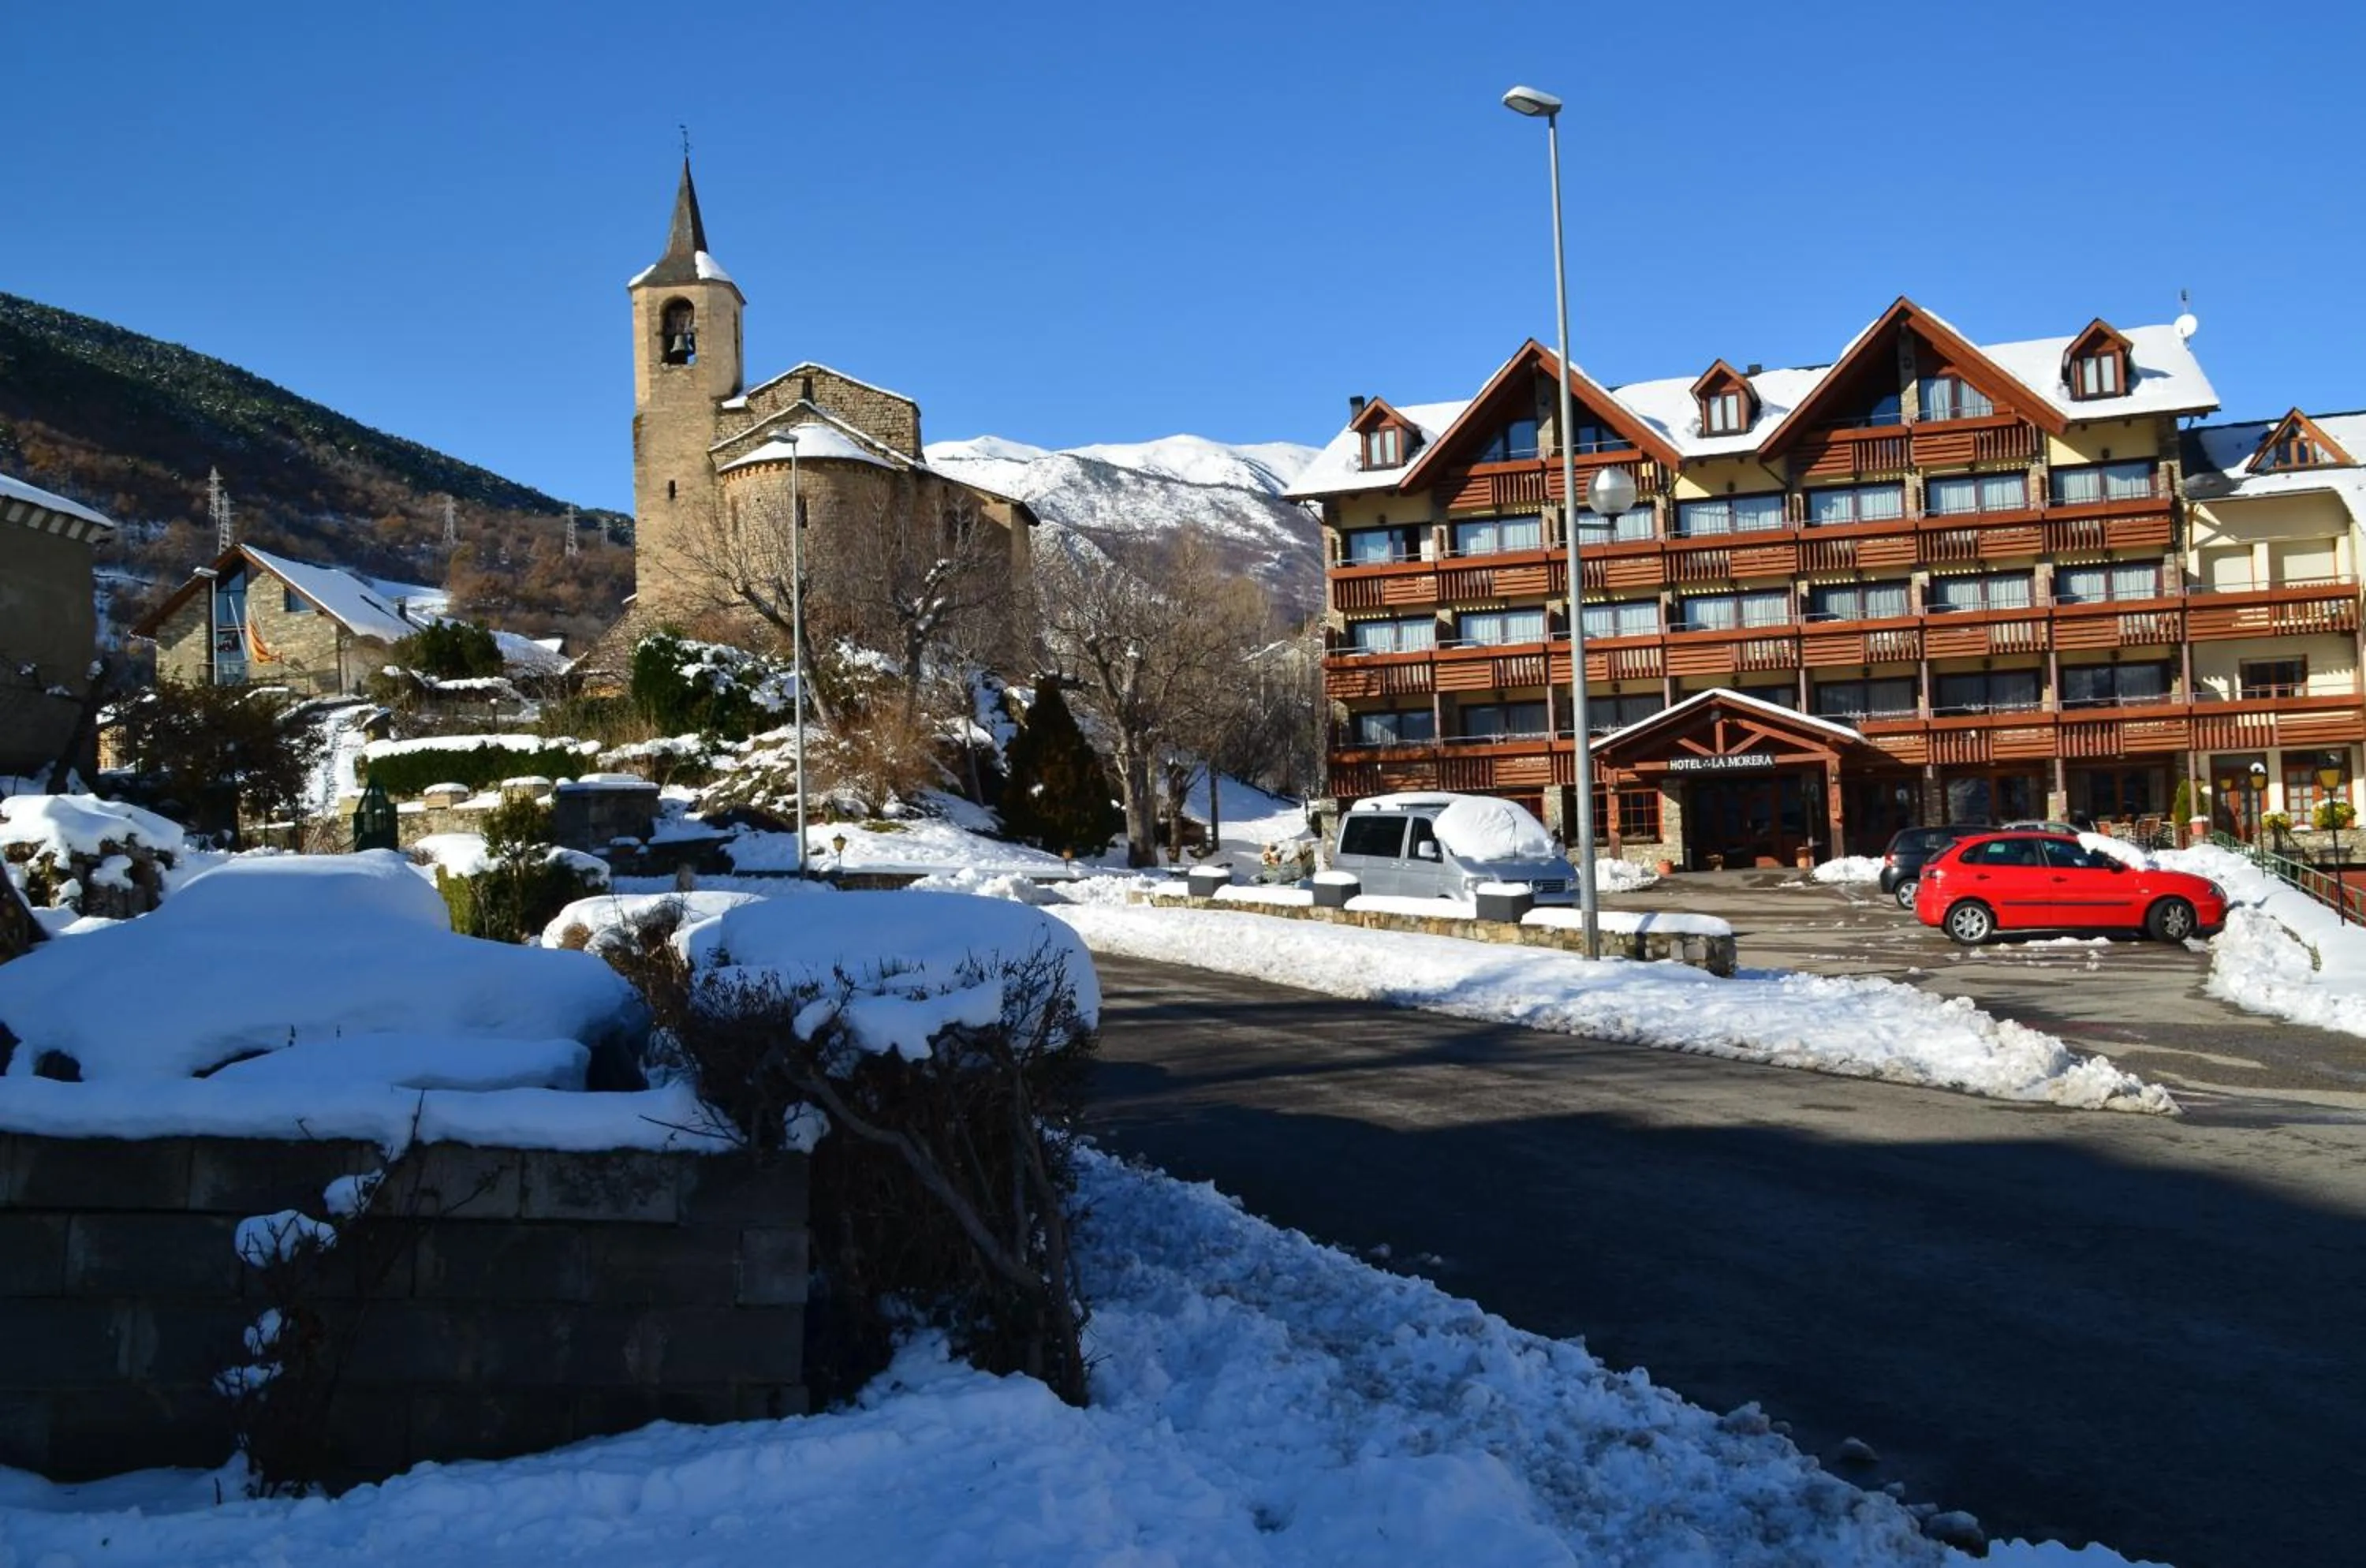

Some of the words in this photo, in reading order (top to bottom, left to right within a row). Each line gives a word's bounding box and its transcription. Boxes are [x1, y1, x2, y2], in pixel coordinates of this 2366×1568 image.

[1670, 758, 1702, 770] HOTEL
[1711, 756, 1726, 768] LA
[1728, 755, 1773, 767] MORERA
